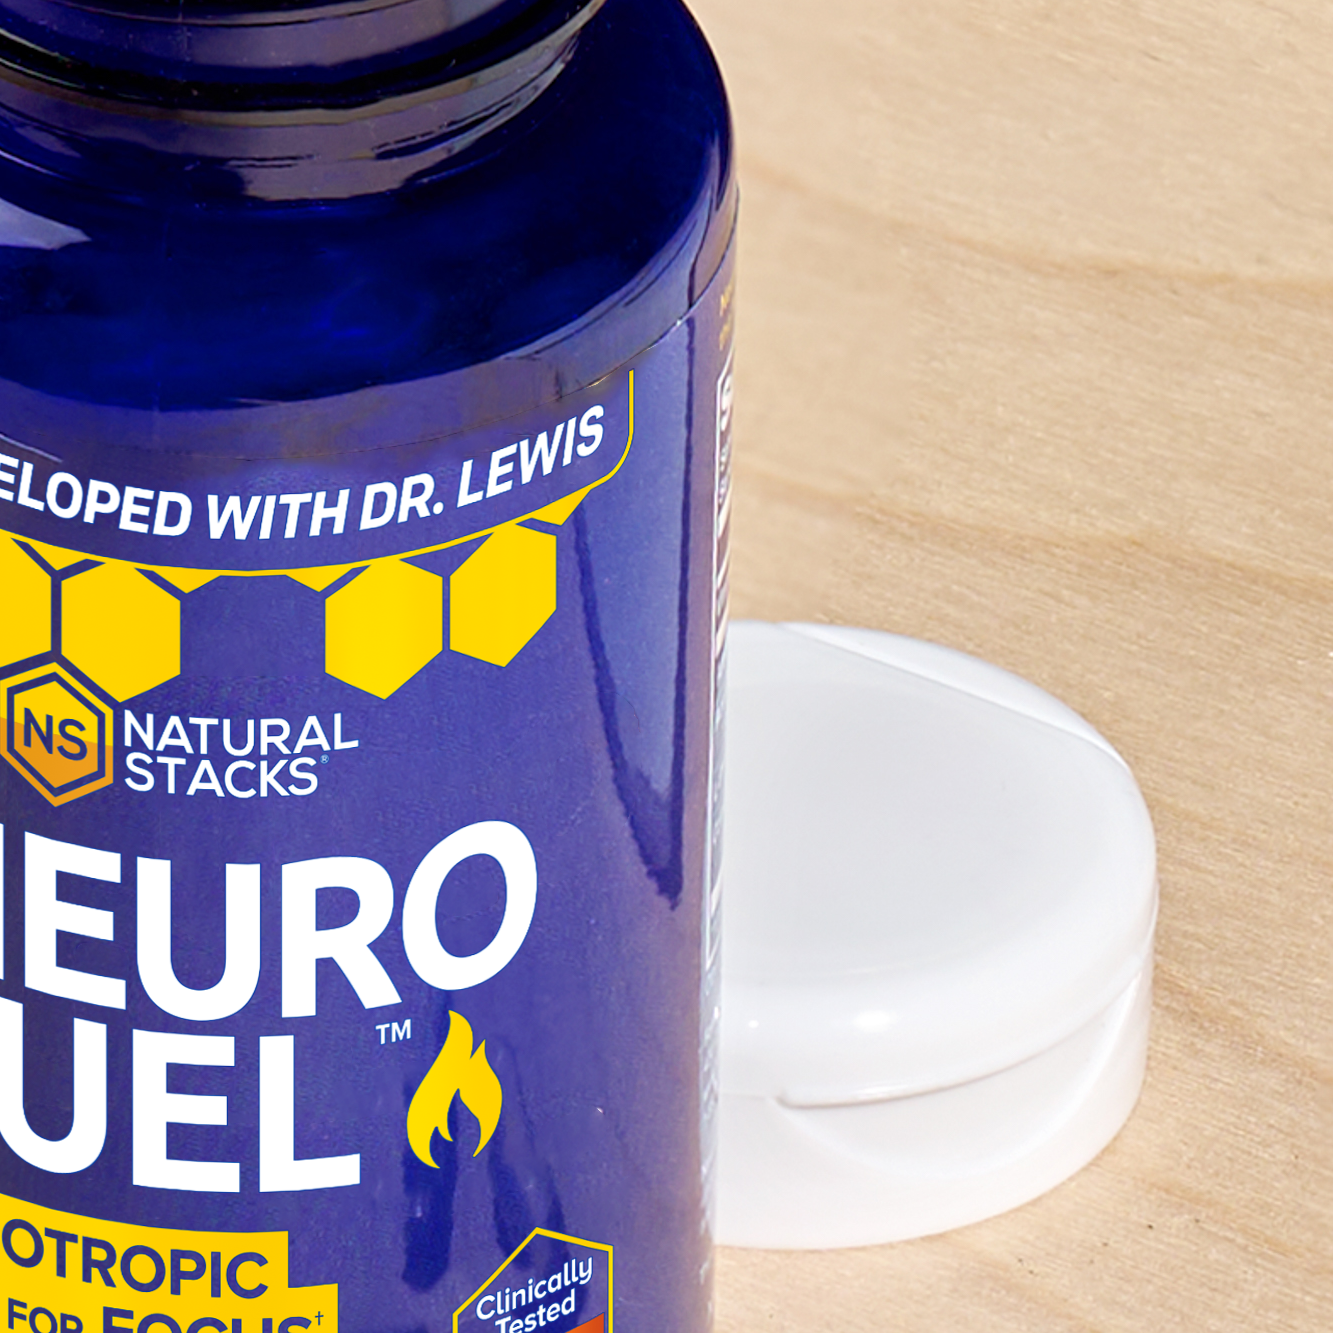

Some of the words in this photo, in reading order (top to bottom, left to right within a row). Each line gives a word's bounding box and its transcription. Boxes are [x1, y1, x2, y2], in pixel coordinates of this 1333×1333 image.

[207, 488, 350, 540] WITH
[359, 473, 444, 531] DR.
[456, 405, 604, 508] LEWIS
[23, 706, 89, 761] NS
[123, 708, 360, 757] NATURAL
[475, 1256, 593, 1321] Clinically
